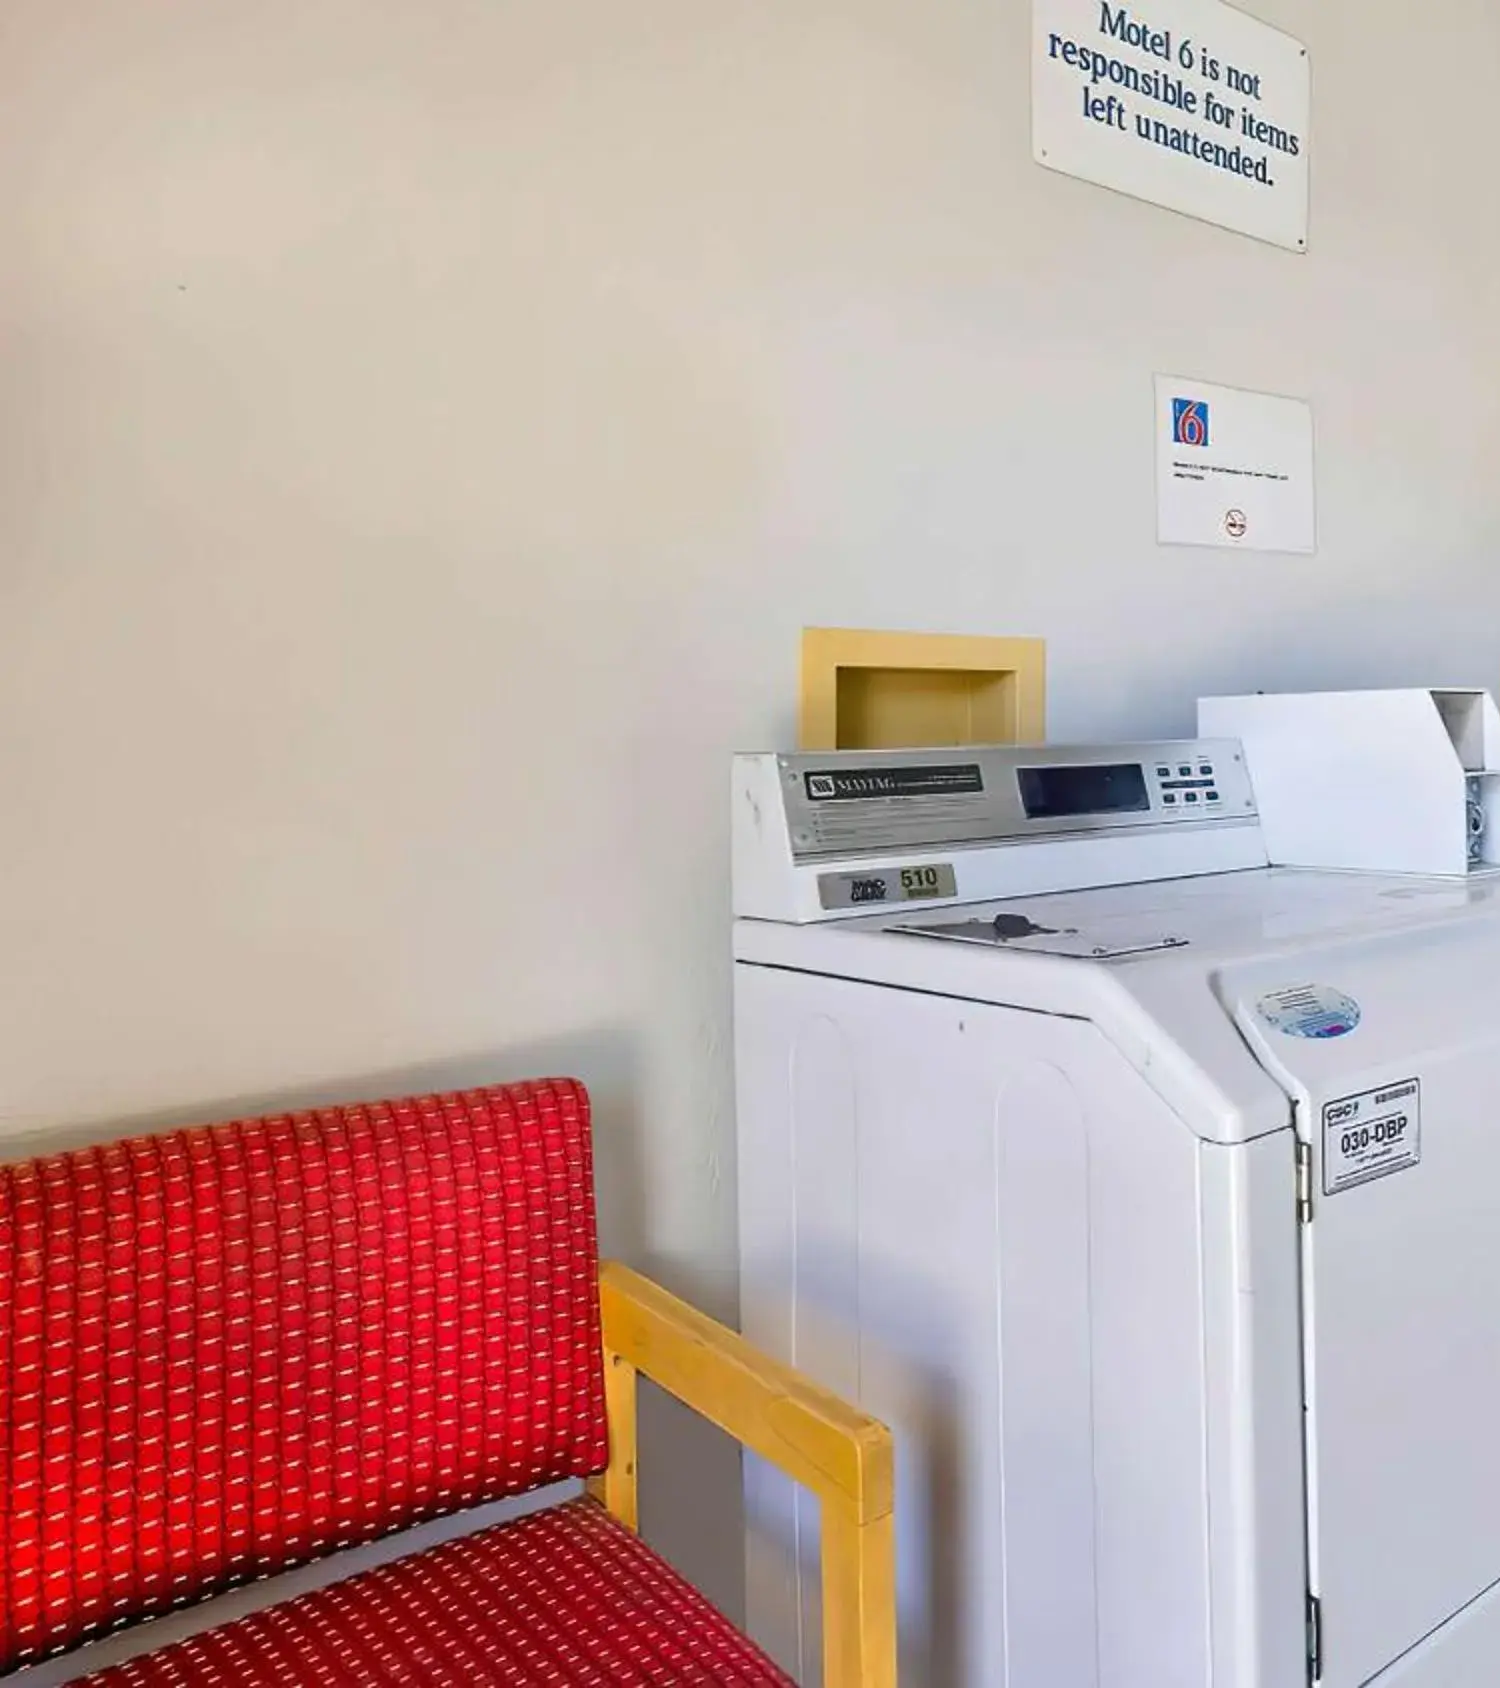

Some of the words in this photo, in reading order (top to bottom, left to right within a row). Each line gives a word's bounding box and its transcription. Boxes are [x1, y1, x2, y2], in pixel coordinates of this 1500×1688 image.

[1048, 33, 1197, 115] responsible
[1204, 92, 1234, 129] for
[1241, 107, 1300, 156] items
[1100, 1, 1171, 61] Motel
[1178, 39, 1195, 69] 6
[1201, 48, 1219, 81] is
[1227, 65, 1262, 100] not
[1083, 86, 1127, 131] left
[1135, 113, 1274, 187] unattended.
[901, 867, 938, 889] 510
[1340, 1115, 1409, 1154] 030-DBP
